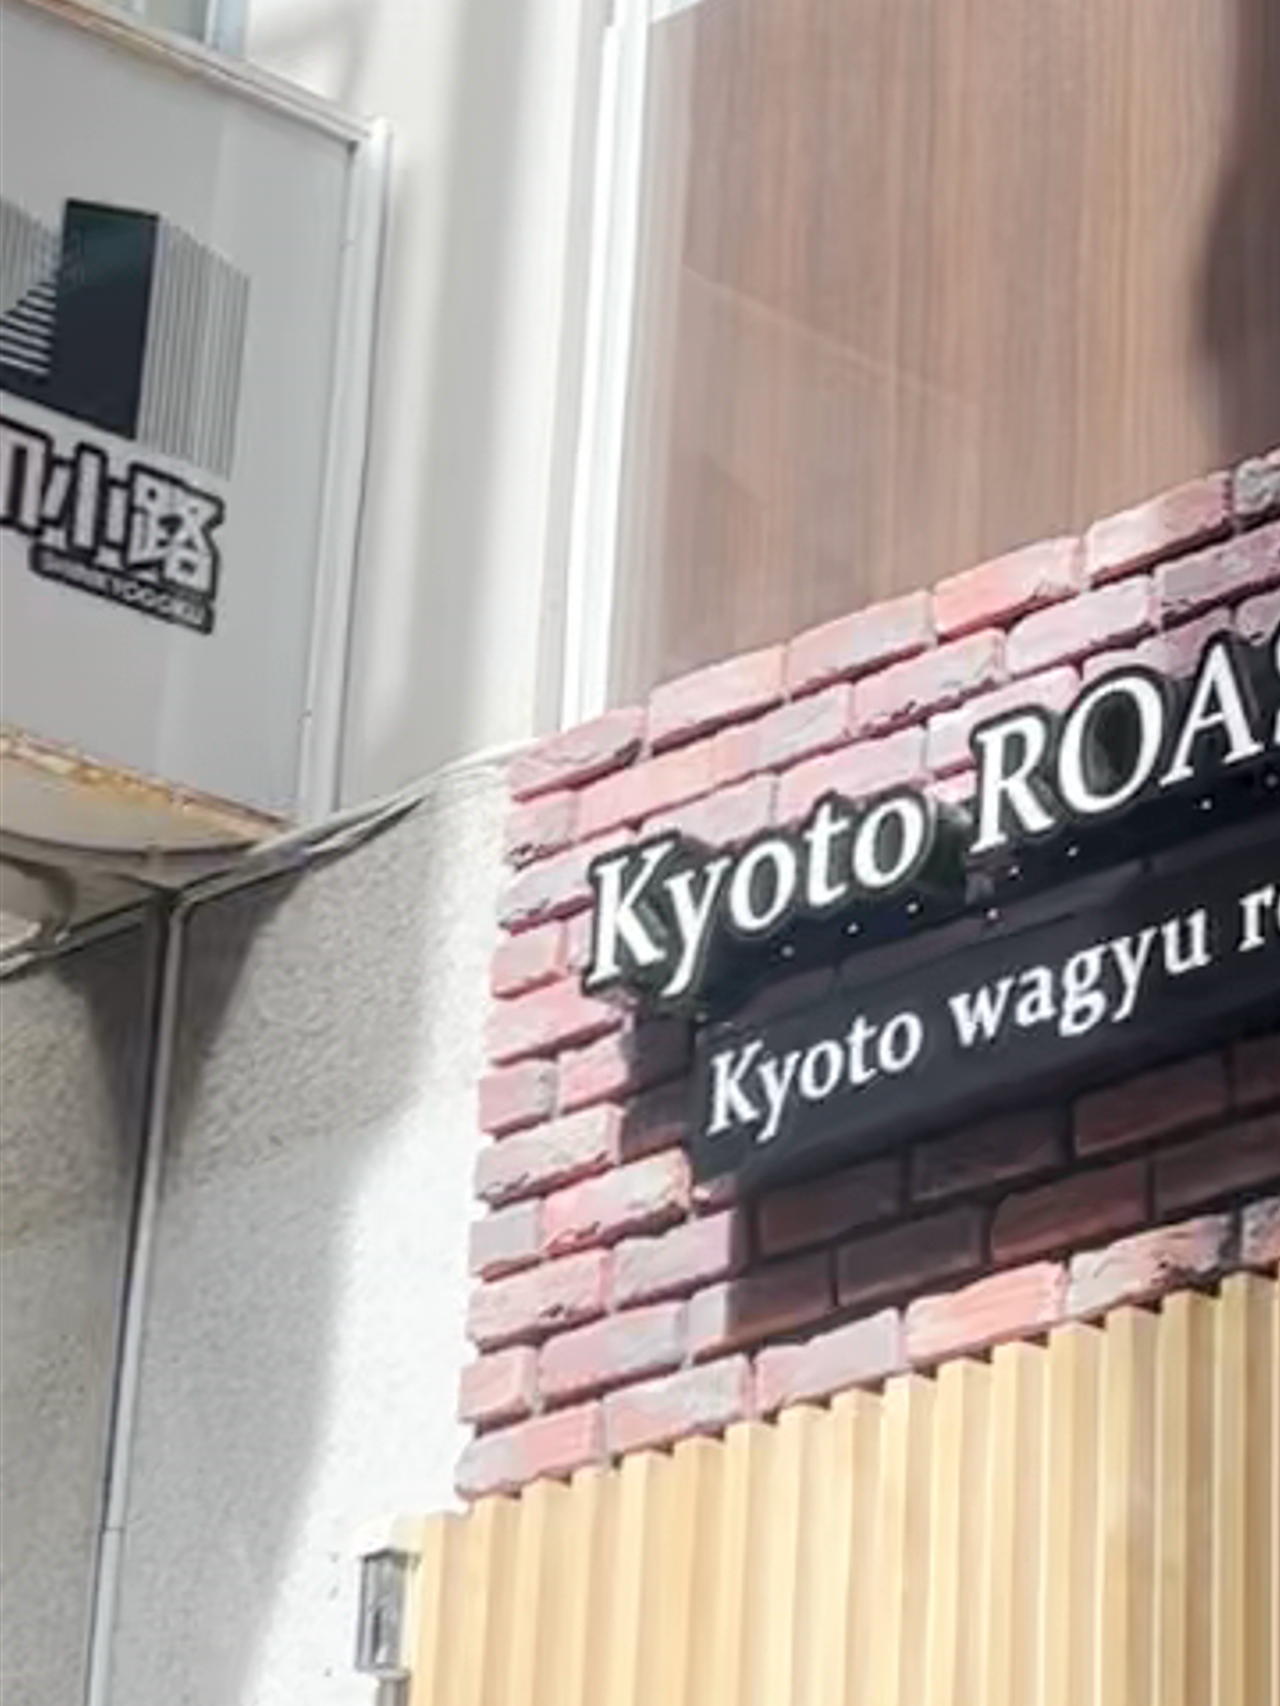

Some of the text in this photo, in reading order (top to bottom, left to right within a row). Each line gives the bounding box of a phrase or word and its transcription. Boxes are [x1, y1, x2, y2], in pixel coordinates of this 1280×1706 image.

[586, 792, 925, 994] Kyoto
[706, 1012, 925, 1142] Kyoto
[948, 918, 1213, 1040] wagyu
